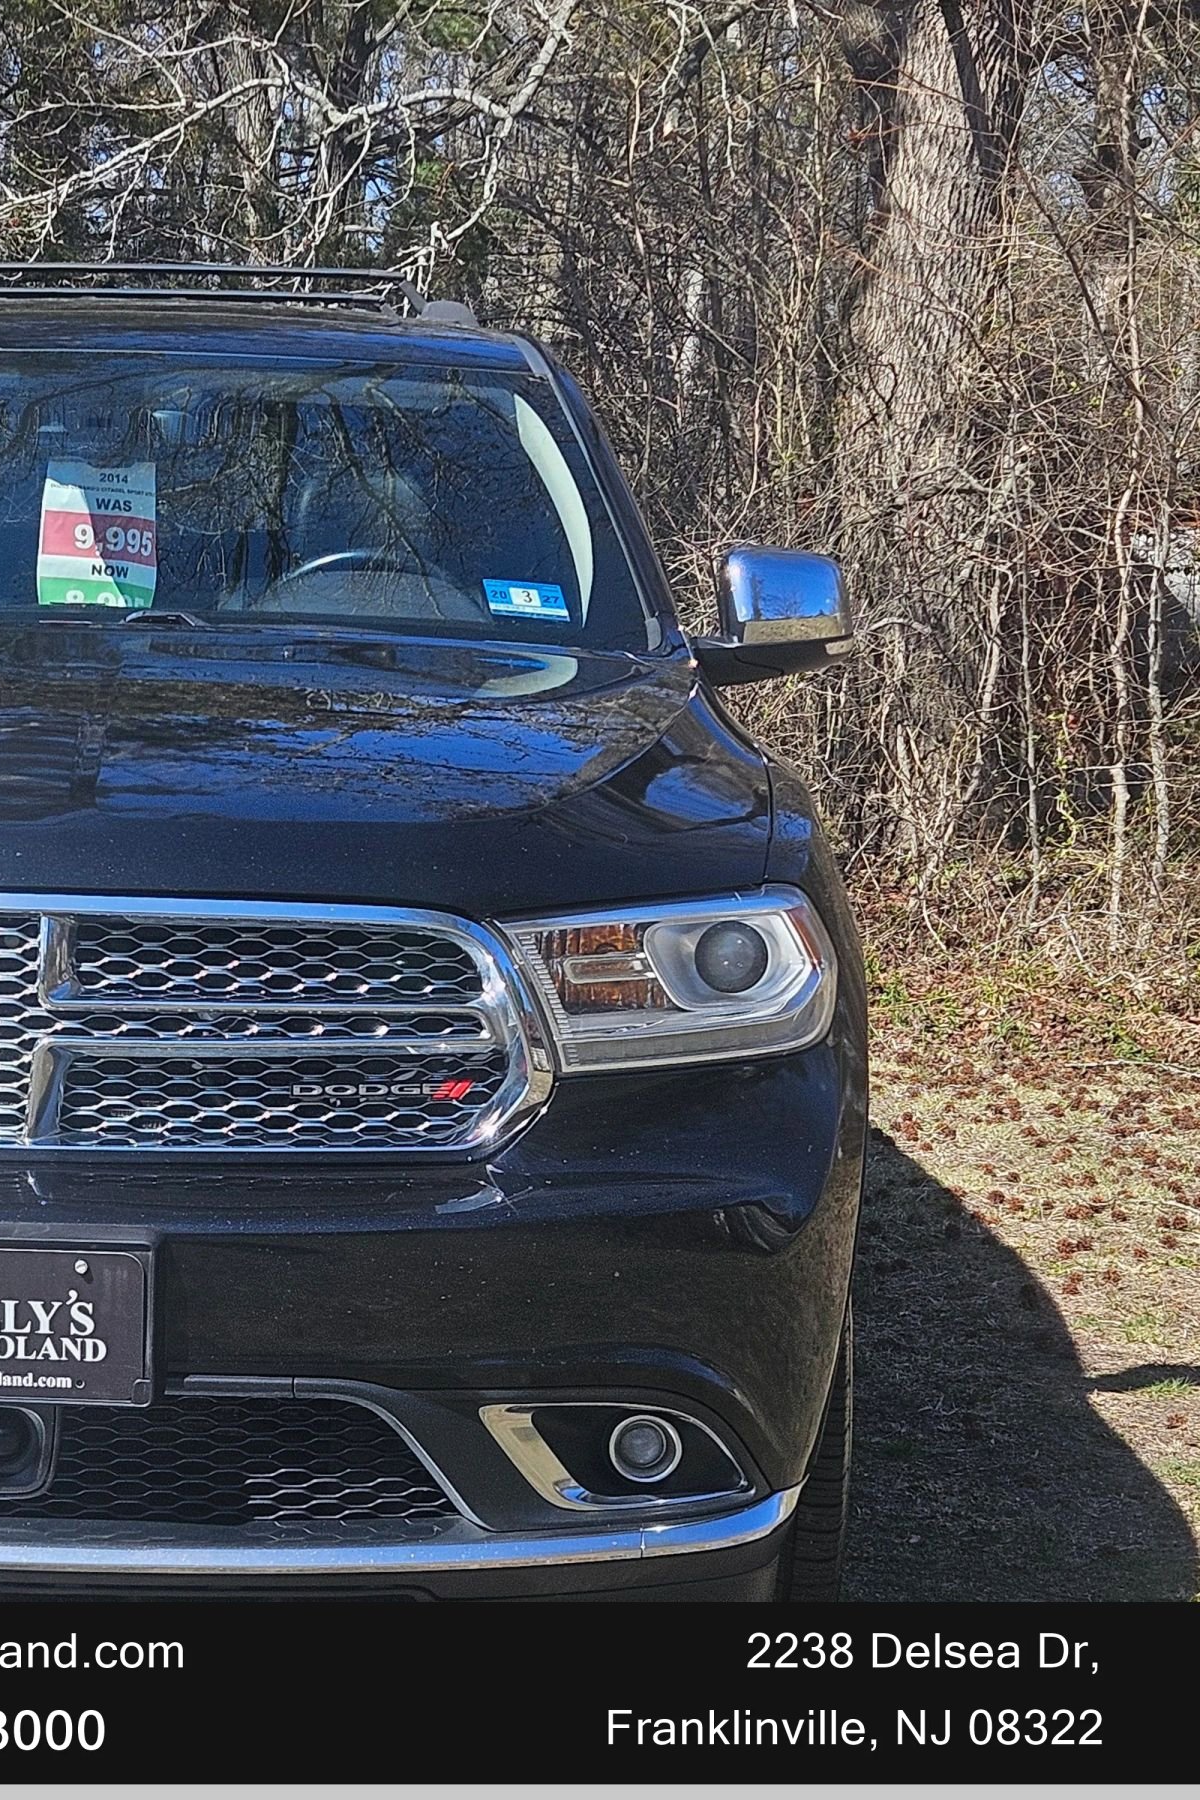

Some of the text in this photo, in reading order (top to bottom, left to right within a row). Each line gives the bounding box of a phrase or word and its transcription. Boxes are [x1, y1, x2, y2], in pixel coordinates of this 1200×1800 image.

[99, 472, 129, 485] 2014
[96, 497, 133, 513] WAS
[73, 523, 153, 557] 9,995
[91, 564, 129, 579] NOW
[491, 590, 507, 599] 20
[521, 591, 533, 603] 3
[542, 595, 560, 604] 27
[291, 1082, 443, 1097] DODGE
